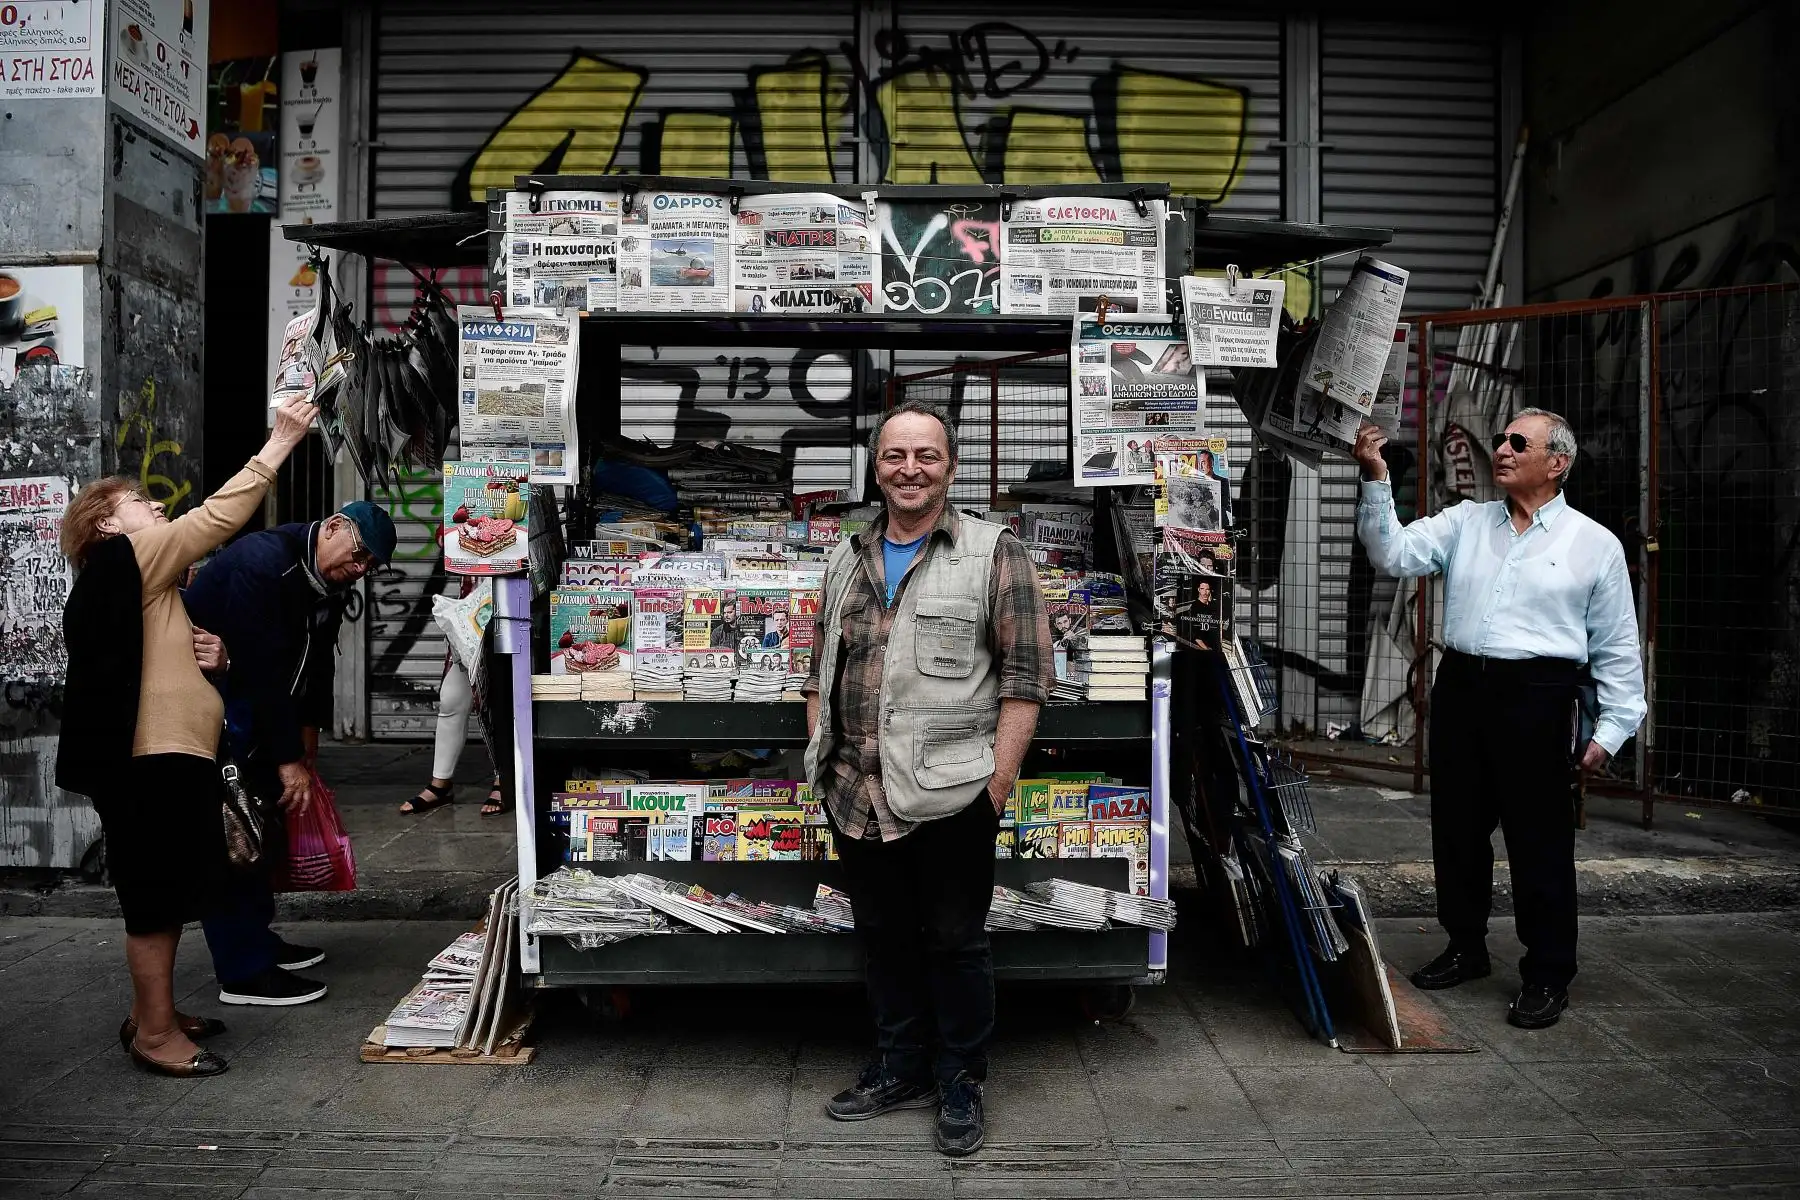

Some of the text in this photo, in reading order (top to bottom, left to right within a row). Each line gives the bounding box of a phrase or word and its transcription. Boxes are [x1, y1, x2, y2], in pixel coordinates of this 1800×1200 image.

[20, 28, 64, 37] Ελληνικός
[0, 36, 87, 46] Ελληνικός διπλός 0,50
[11, 56, 45, 81] ΣΤΗ
[50, 57, 94, 80] ΣΤΟΑ
[5, 87, 24, 95] τιμές
[25, 86, 50, 94] πακέτο
[57, 85, 74, 93] take
[74, 86, 95, 94] away
[113, 61, 187, 128] ΜΕΣΑ ΣΤΗ ΣΤΟΑ
[653, 195, 723, 210] ΘΑΡΡΟΣ
[1048, 207, 1117, 221] ΕΛΕΥΘΕΡΙΑ
[651, 221, 684, 230] ΚΑΛΑΜΑΤΑ:
[776, 231, 835, 246] ΠΑΤΡΙΣ
[533, 241, 617, 258] Η παχυσαρκί
[580, 259, 608, 269] καρκίνο
[770, 289, 841, 307] «ΠΛΑΣΤΟ»
[1213, 305, 1254, 322] Εγνατία
[463, 323, 534, 337] ΕΛΕΥΘΕΡΙΑ
[1102, 325, 1173, 337] ΘΕΣΣΑΛΙΑ
[481, 347, 507, 355] Σαφάρι
[527, 349, 539, 357] Αγ.
[542, 350, 567, 358] Τριάδα
[496, 357, 528, 365] προϊόντα
[1129, 383, 1196, 391] ΠΟΡΝΟΓΡΑΦΙΑ
[660, 560, 715, 572] crash
[1091, 797, 1149, 820] ΠΑΖΛ
